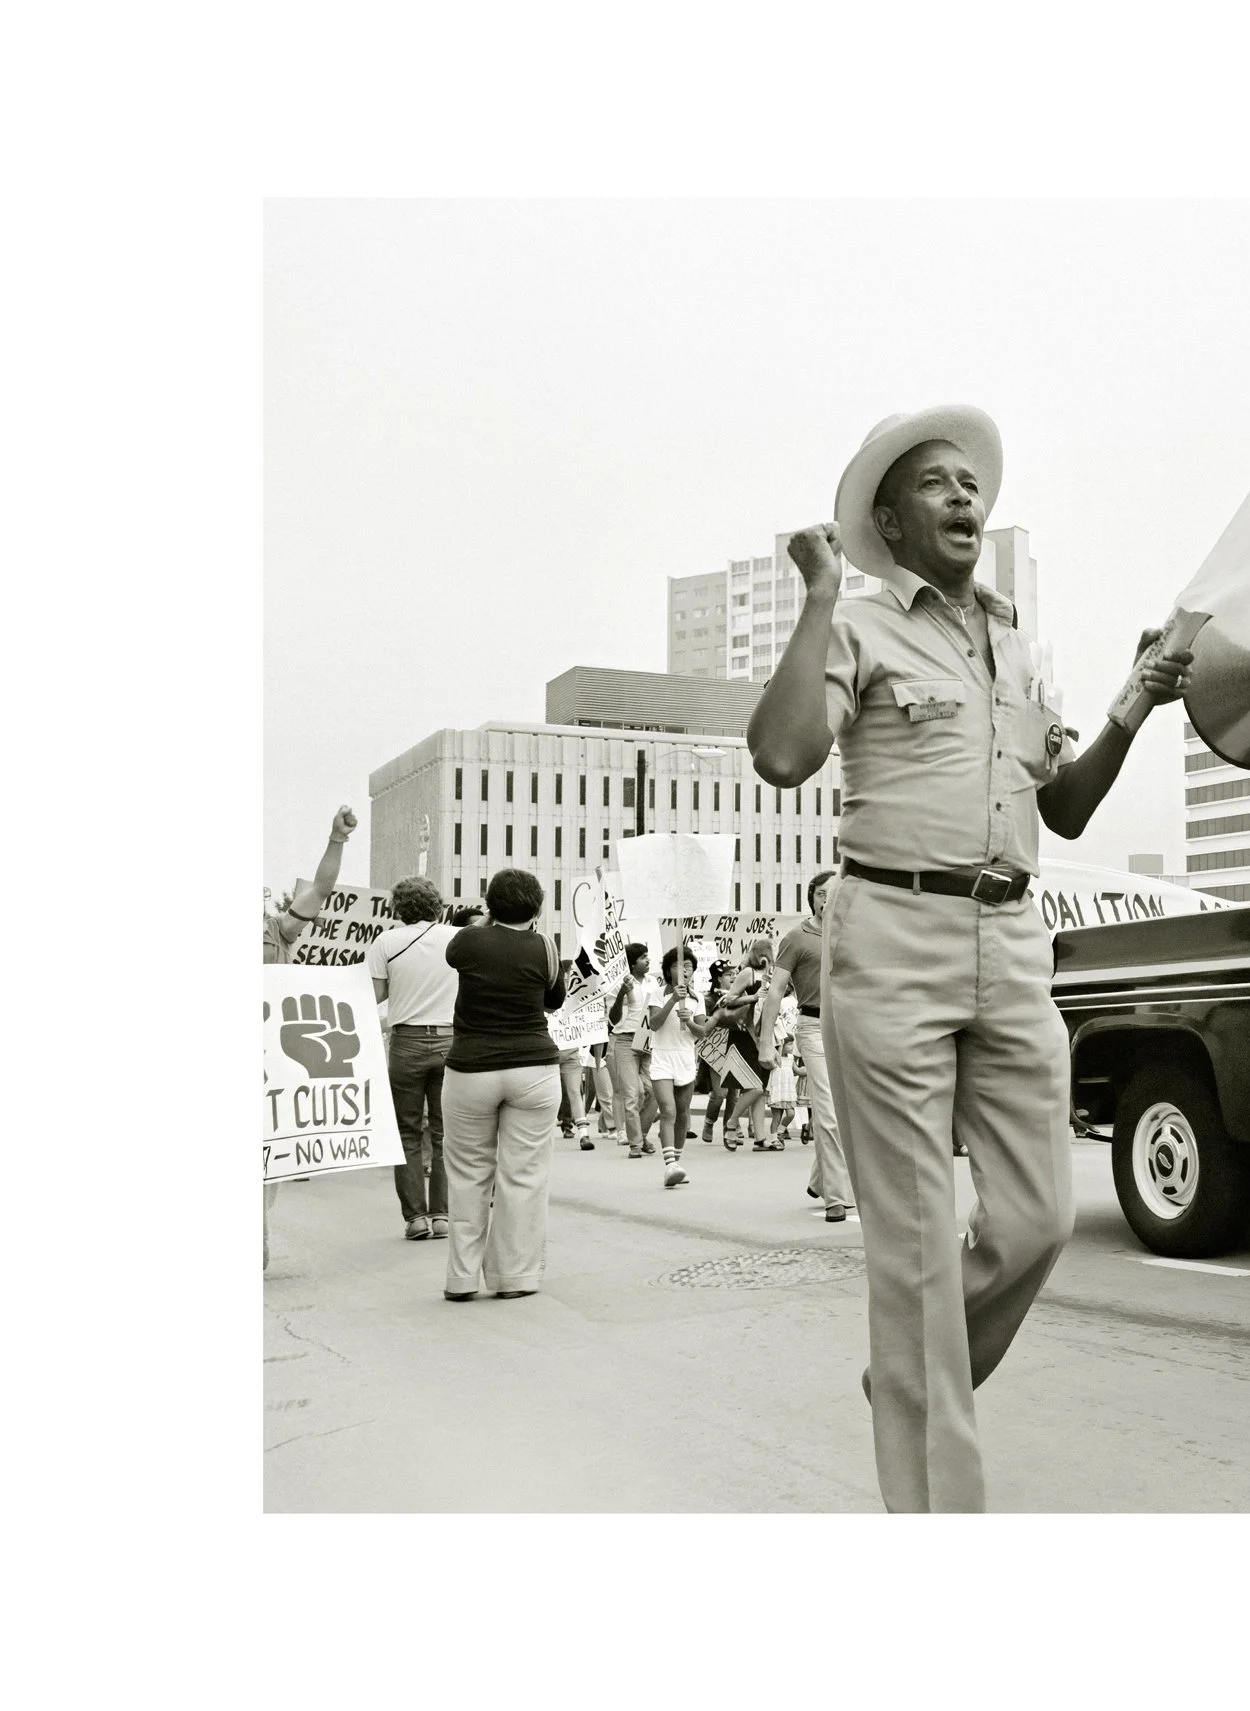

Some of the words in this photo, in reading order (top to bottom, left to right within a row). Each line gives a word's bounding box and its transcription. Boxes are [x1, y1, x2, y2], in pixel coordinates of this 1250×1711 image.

[320, 891, 358, 914] TOP
[1026, 888, 1164, 931] OALITION
[715, 916, 738, 932] FOR
[293, 1078, 371, 1129] CUTS!
[295, 1138, 324, 1166] NO
[329, 1135, 370, 1160] WAR
